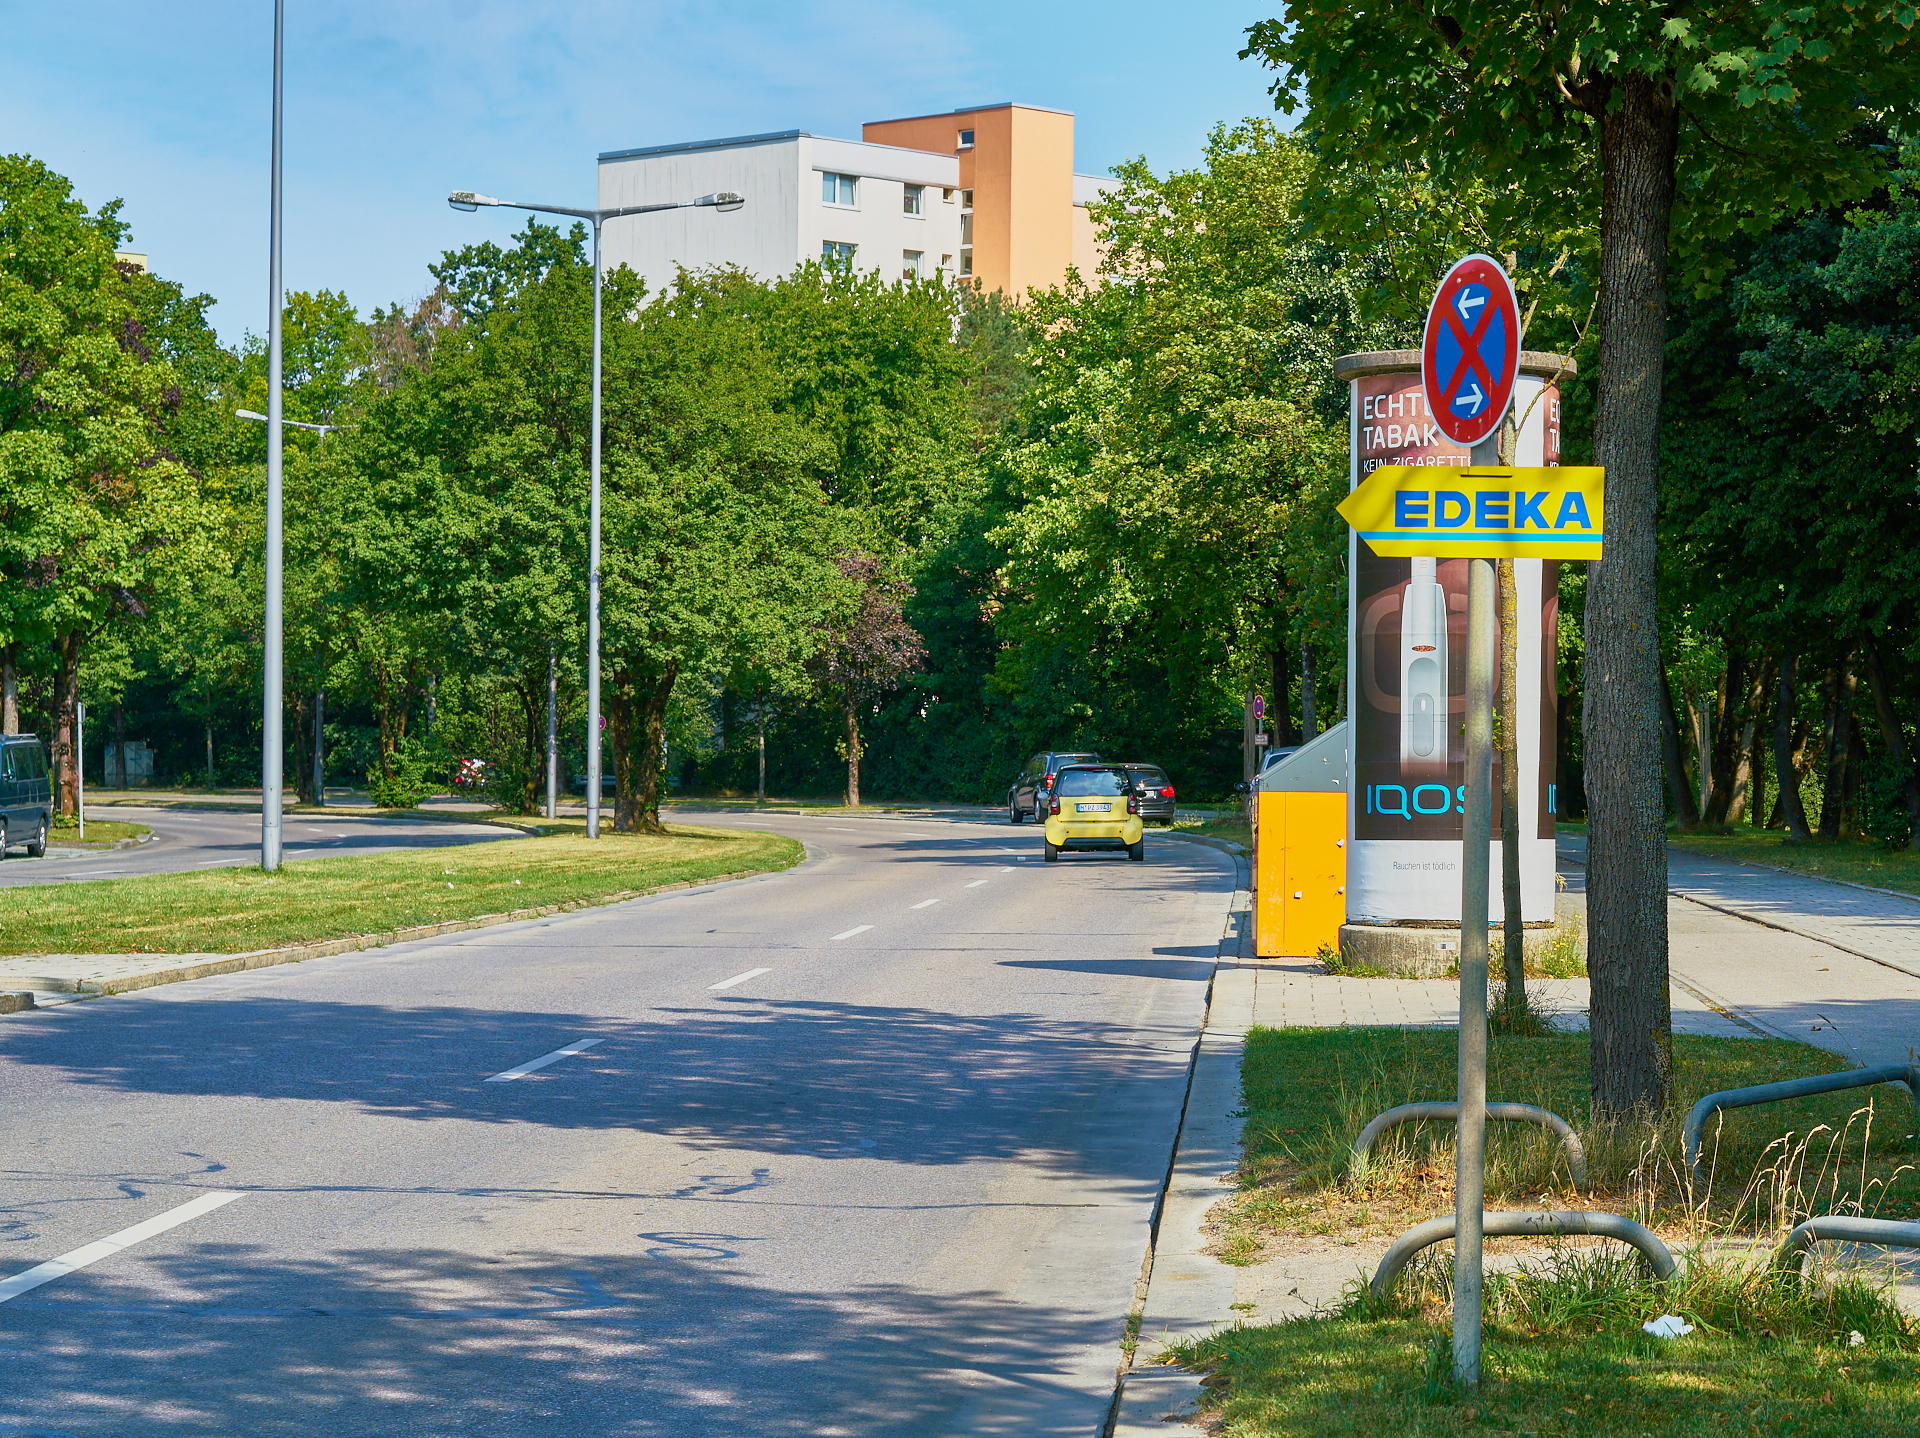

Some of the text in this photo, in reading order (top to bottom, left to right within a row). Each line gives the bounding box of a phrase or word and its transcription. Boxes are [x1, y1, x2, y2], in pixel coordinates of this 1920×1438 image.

[1363, 422, 1440, 451] TABAK
[1394, 490, 1593, 530] EDEKA
[1392, 860, 1456, 871] Rauchen ist tödlich
